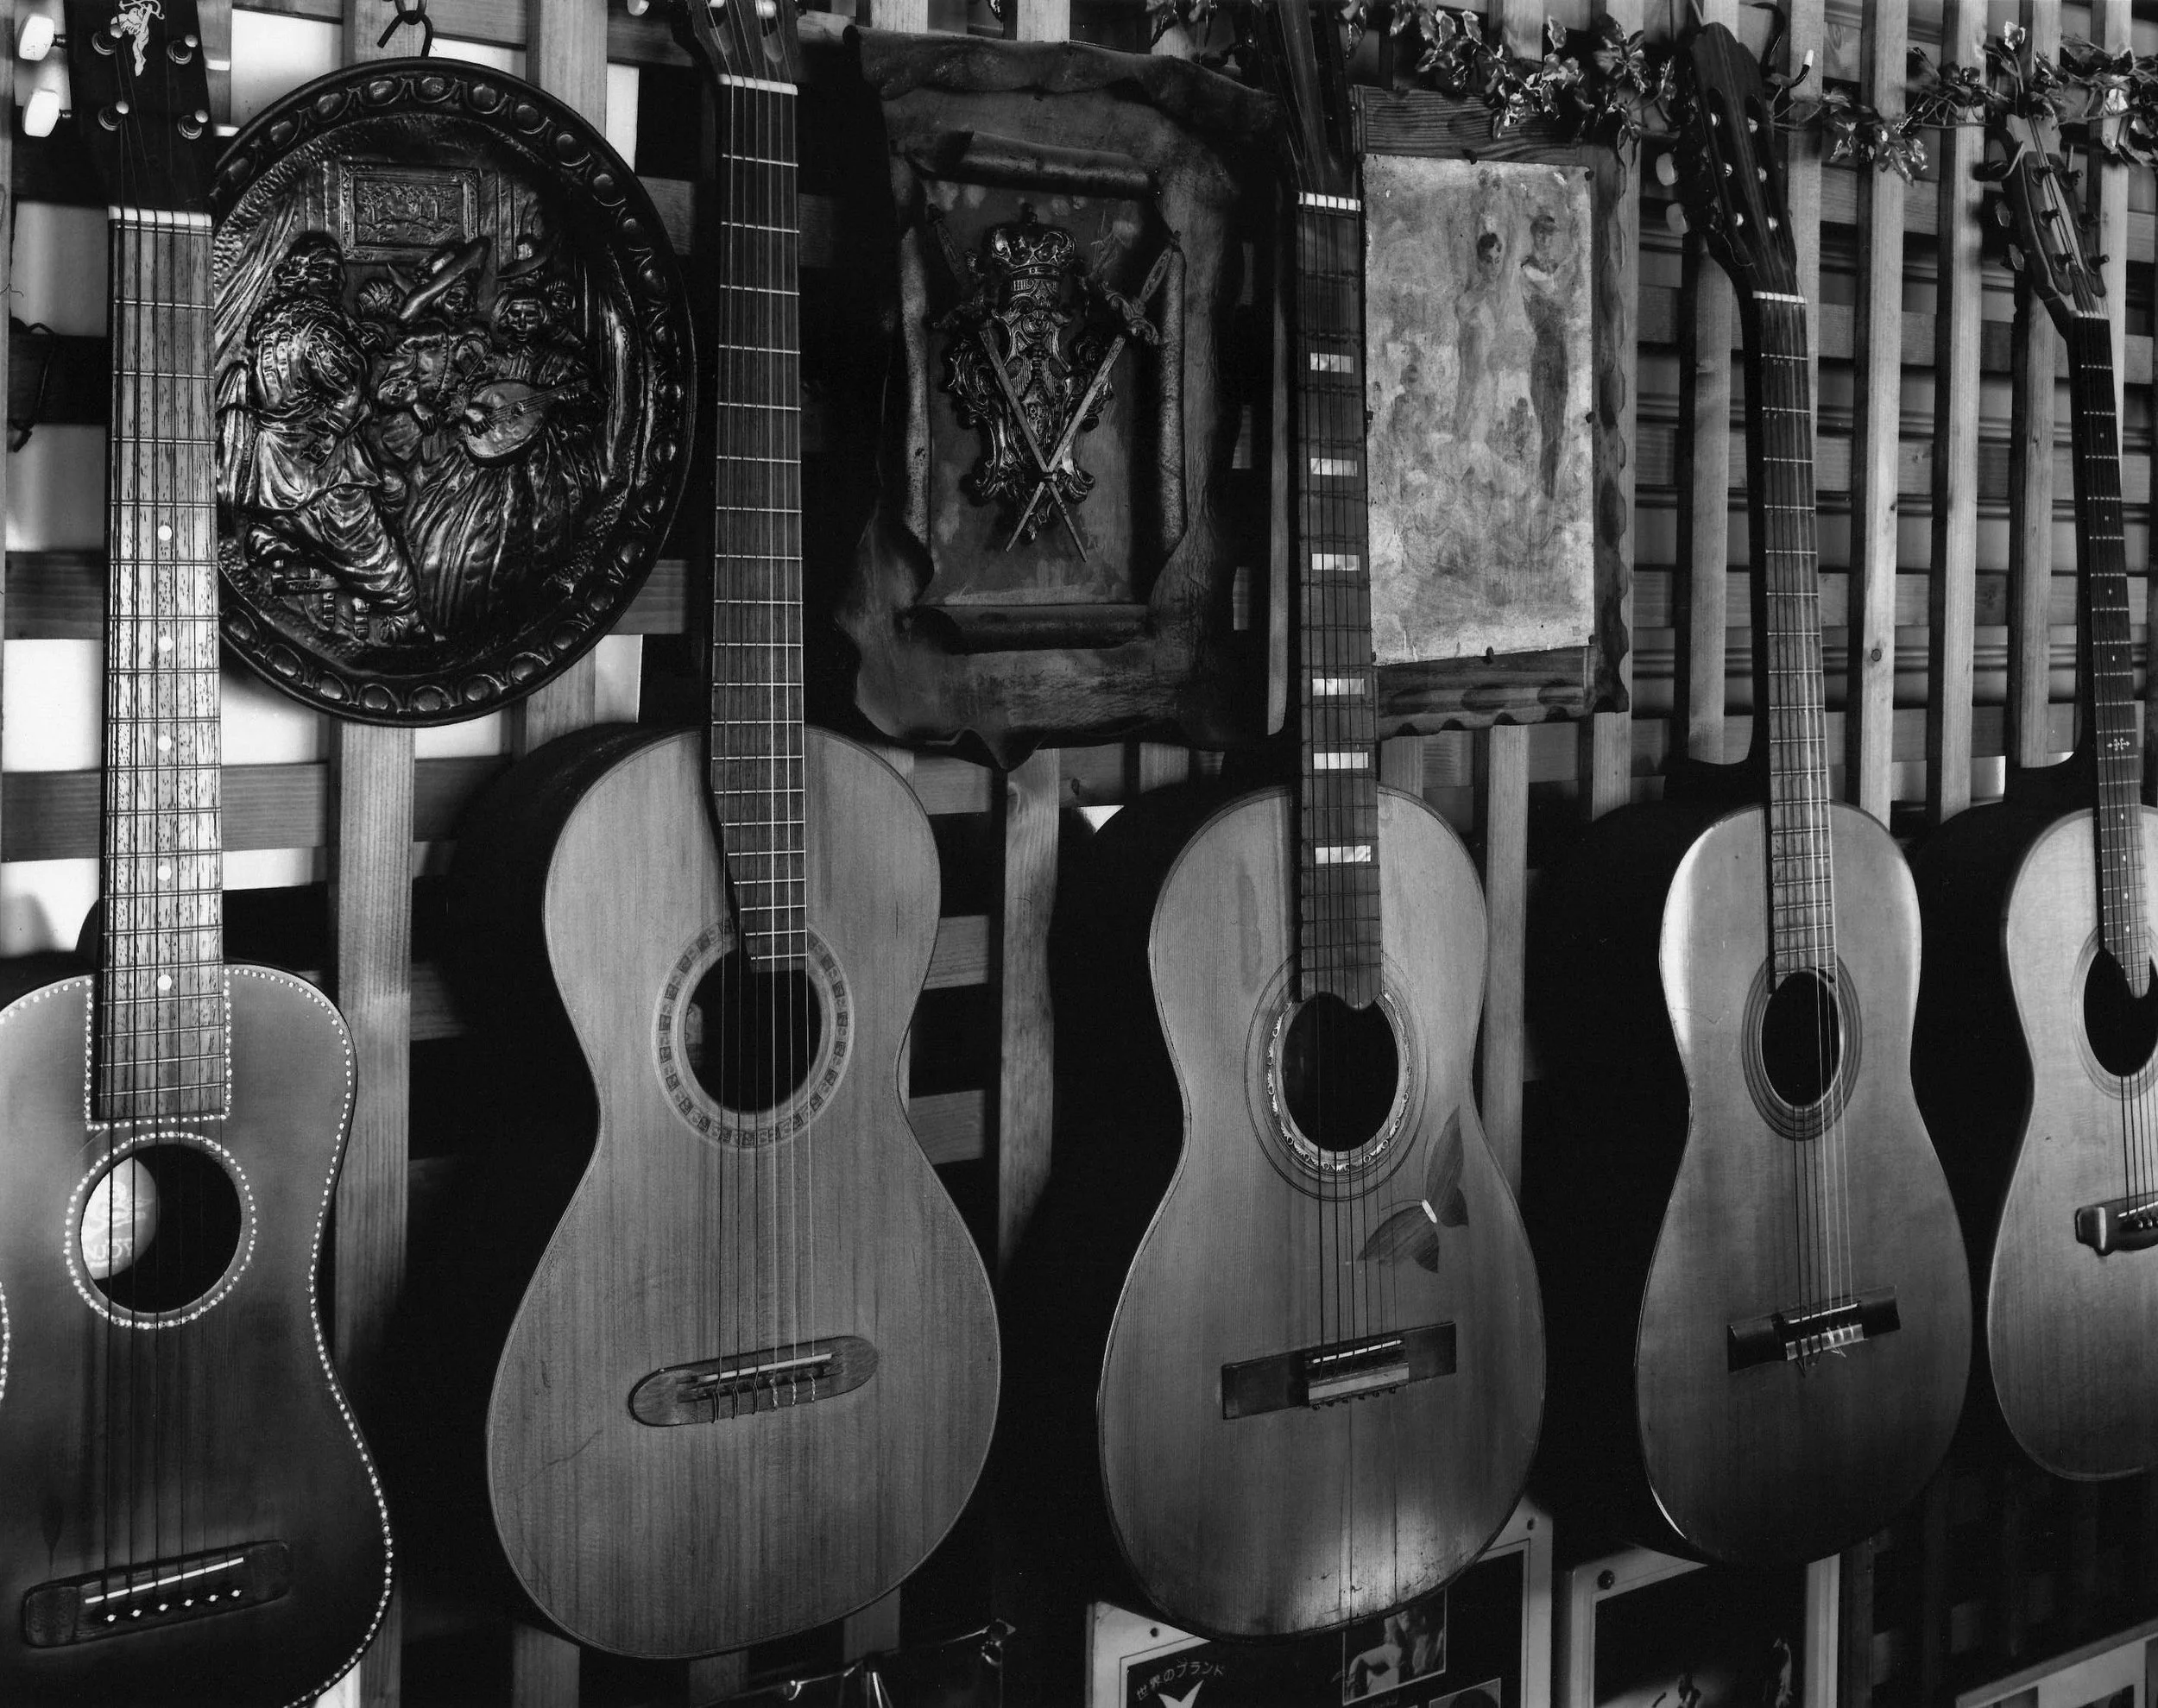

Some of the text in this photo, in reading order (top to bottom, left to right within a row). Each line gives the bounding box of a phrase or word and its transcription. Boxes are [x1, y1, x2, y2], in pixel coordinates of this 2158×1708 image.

[1137, 1658, 1224, 1700] 世界のブランド
